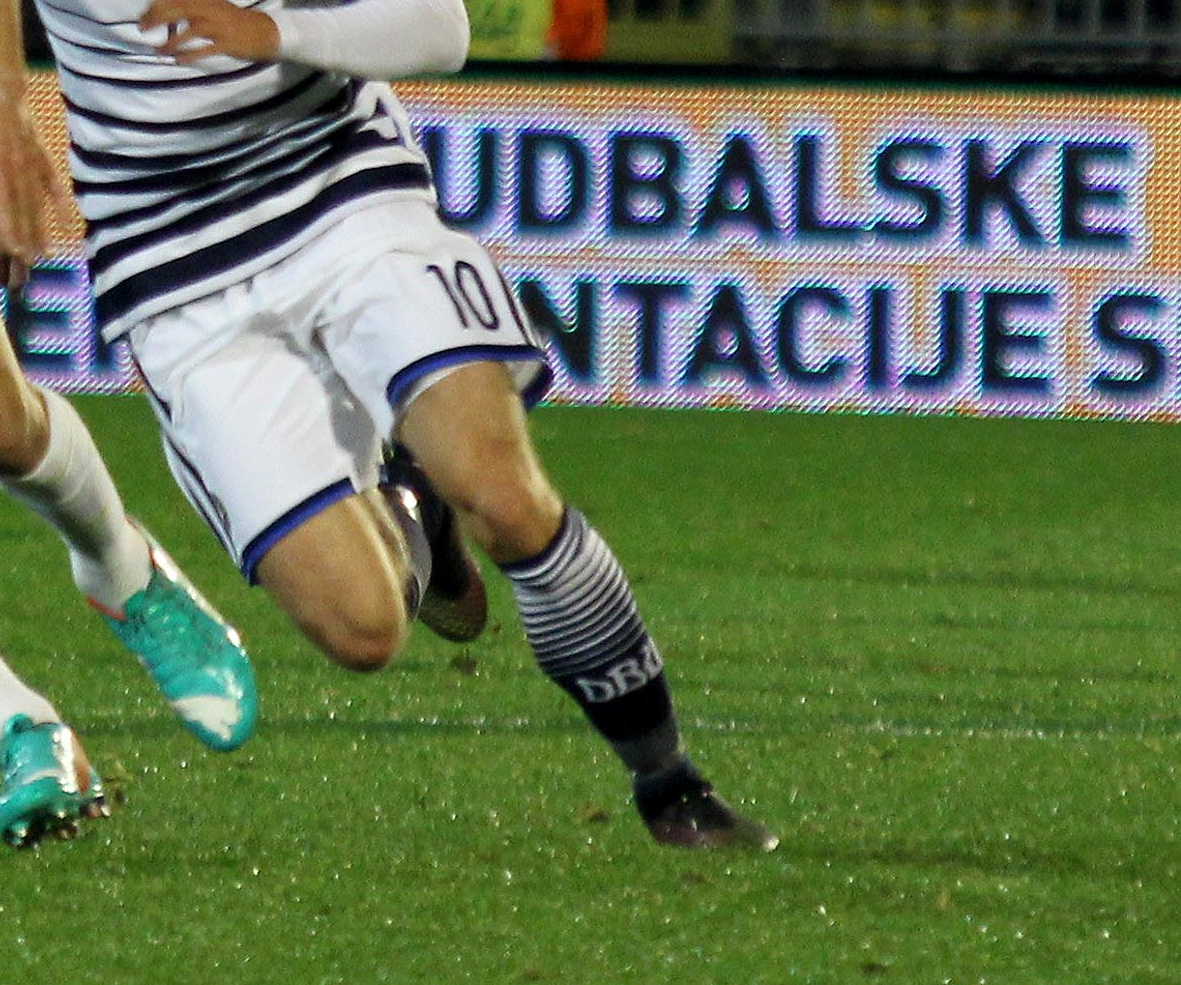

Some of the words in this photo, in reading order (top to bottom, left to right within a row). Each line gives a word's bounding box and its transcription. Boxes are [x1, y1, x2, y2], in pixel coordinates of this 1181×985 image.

[422, 126, 1135, 250] UDBALSKE
[425, 260, 500, 330] 10
[517, 277, 1055, 394] NTACIJE
[1090, 291, 1171, 396] S
